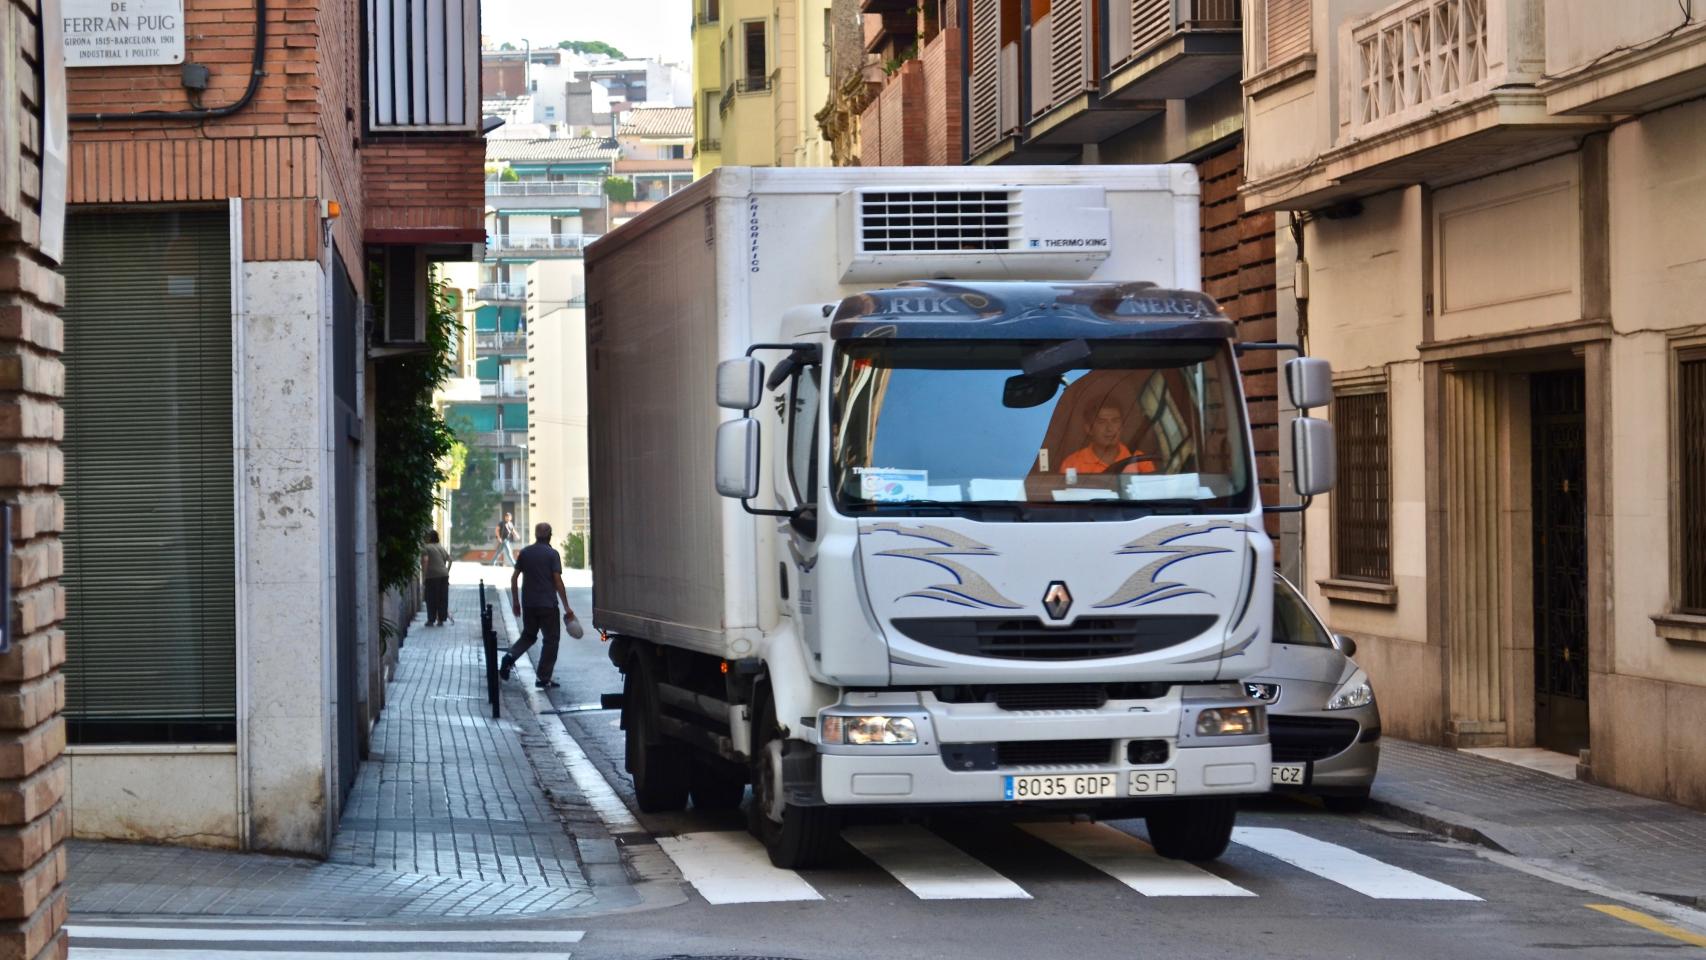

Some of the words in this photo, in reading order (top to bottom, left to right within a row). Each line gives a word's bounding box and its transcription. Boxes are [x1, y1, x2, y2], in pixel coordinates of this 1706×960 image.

[111, 2, 127, 12] DE
[63, 17, 129, 33] FERRAN
[137, 15, 175, 31] PUIG
[64, 37, 91, 46] GIRONA
[79, 50, 121, 59] INDUSTRIAL
[1044, 239, 1084, 247] THERMO
[1085, 238, 1107, 247] KING
[876, 297, 959, 314] RIK
[1017, 777, 1067, 796] 8035
[1074, 776, 1111, 795] GDP
[1135, 773, 1170, 792] SP
